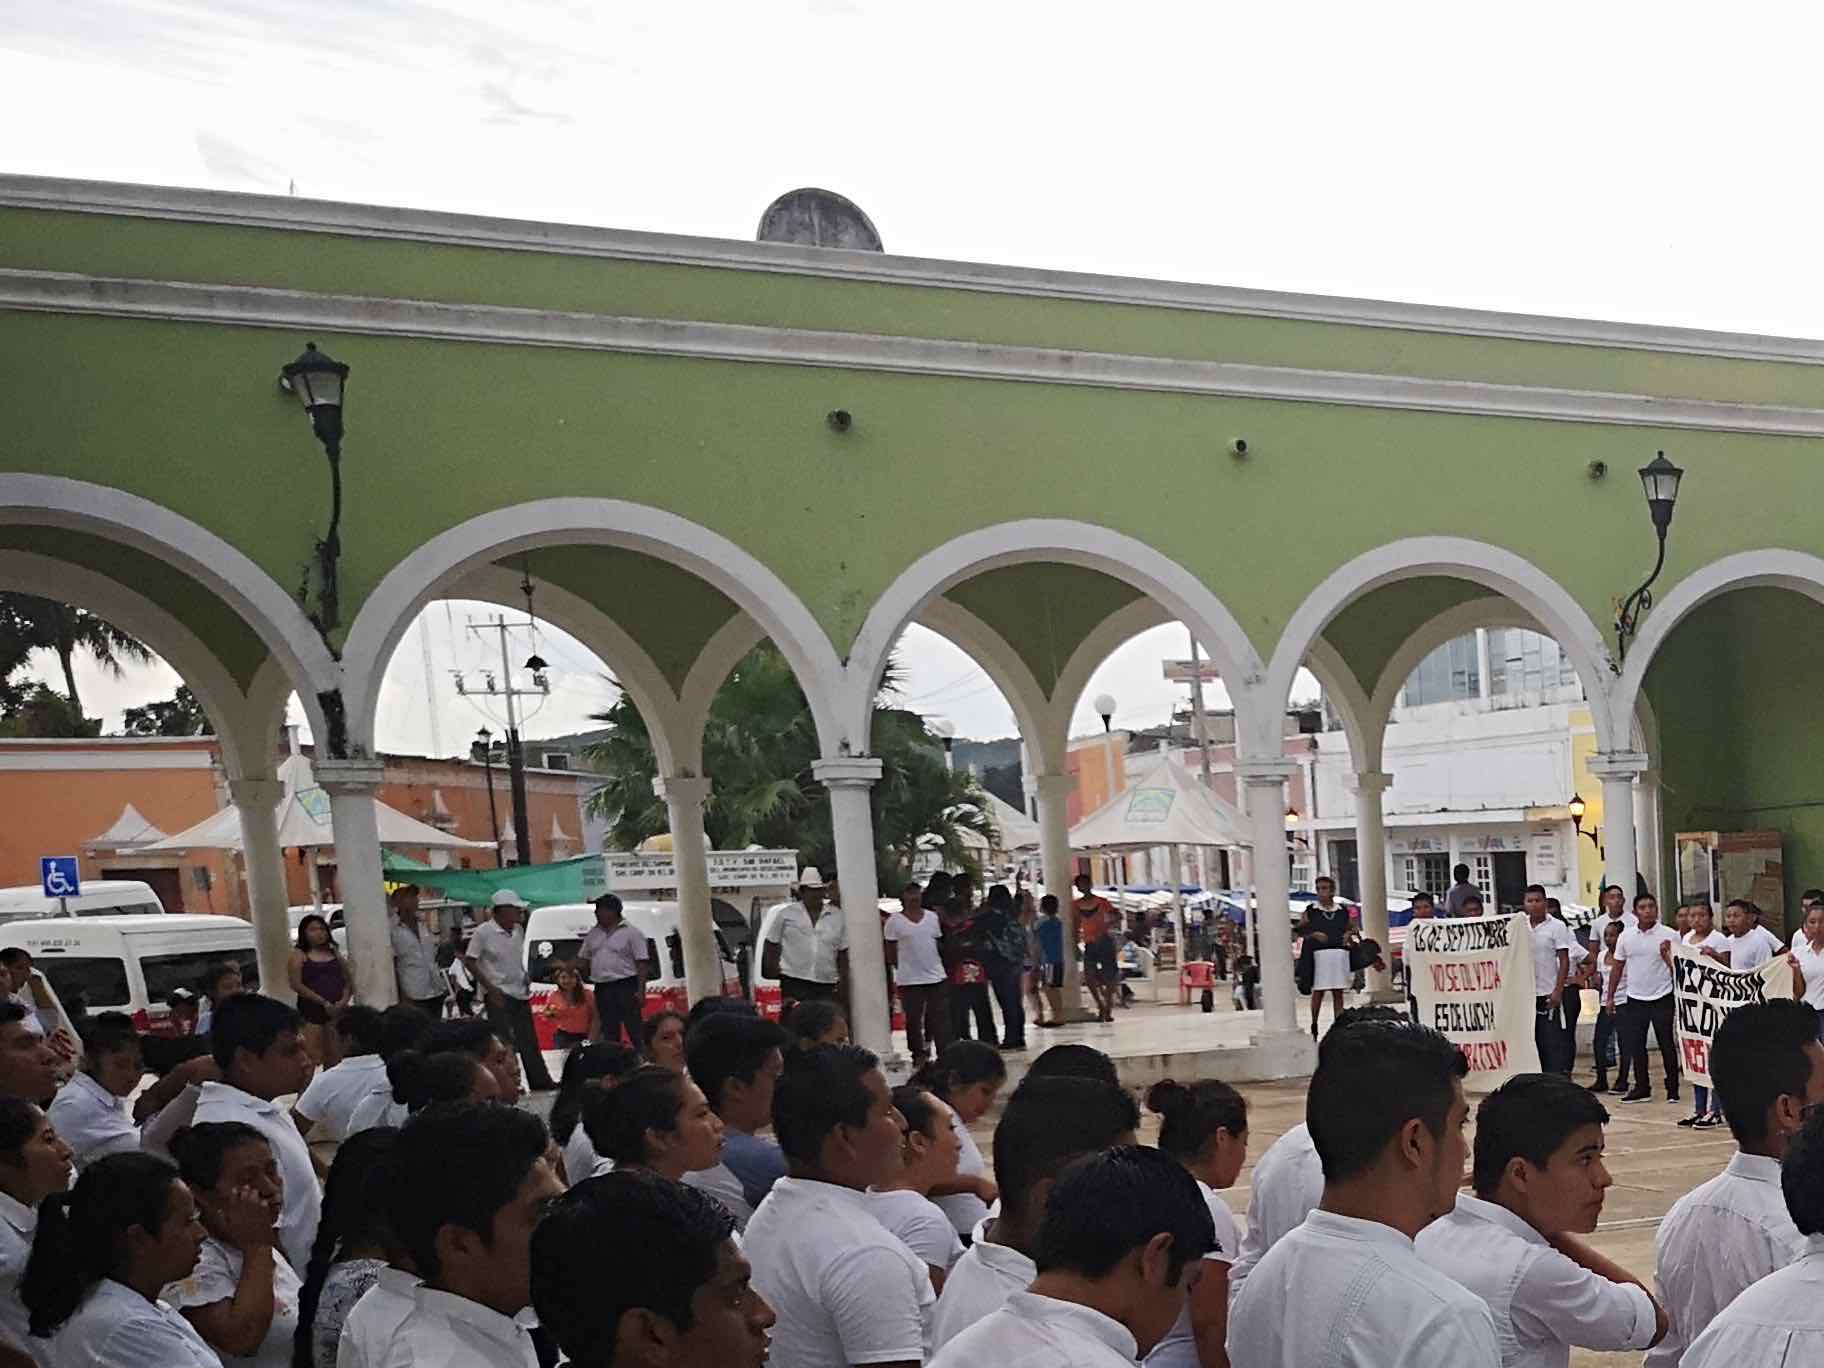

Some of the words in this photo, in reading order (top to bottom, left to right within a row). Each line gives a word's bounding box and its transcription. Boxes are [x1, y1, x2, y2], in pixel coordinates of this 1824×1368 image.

[1427, 924, 1443, 952] DE
[1443, 917, 1511, 952] SEPTIEMBRE
[1445, 962, 1461, 992] SE
[1459, 960, 1502, 991] OLVIDA
[1435, 1003, 1449, 1032] ES
[1450, 1003, 1464, 1032] DE
[1463, 1000, 1496, 1032] LUCHA
